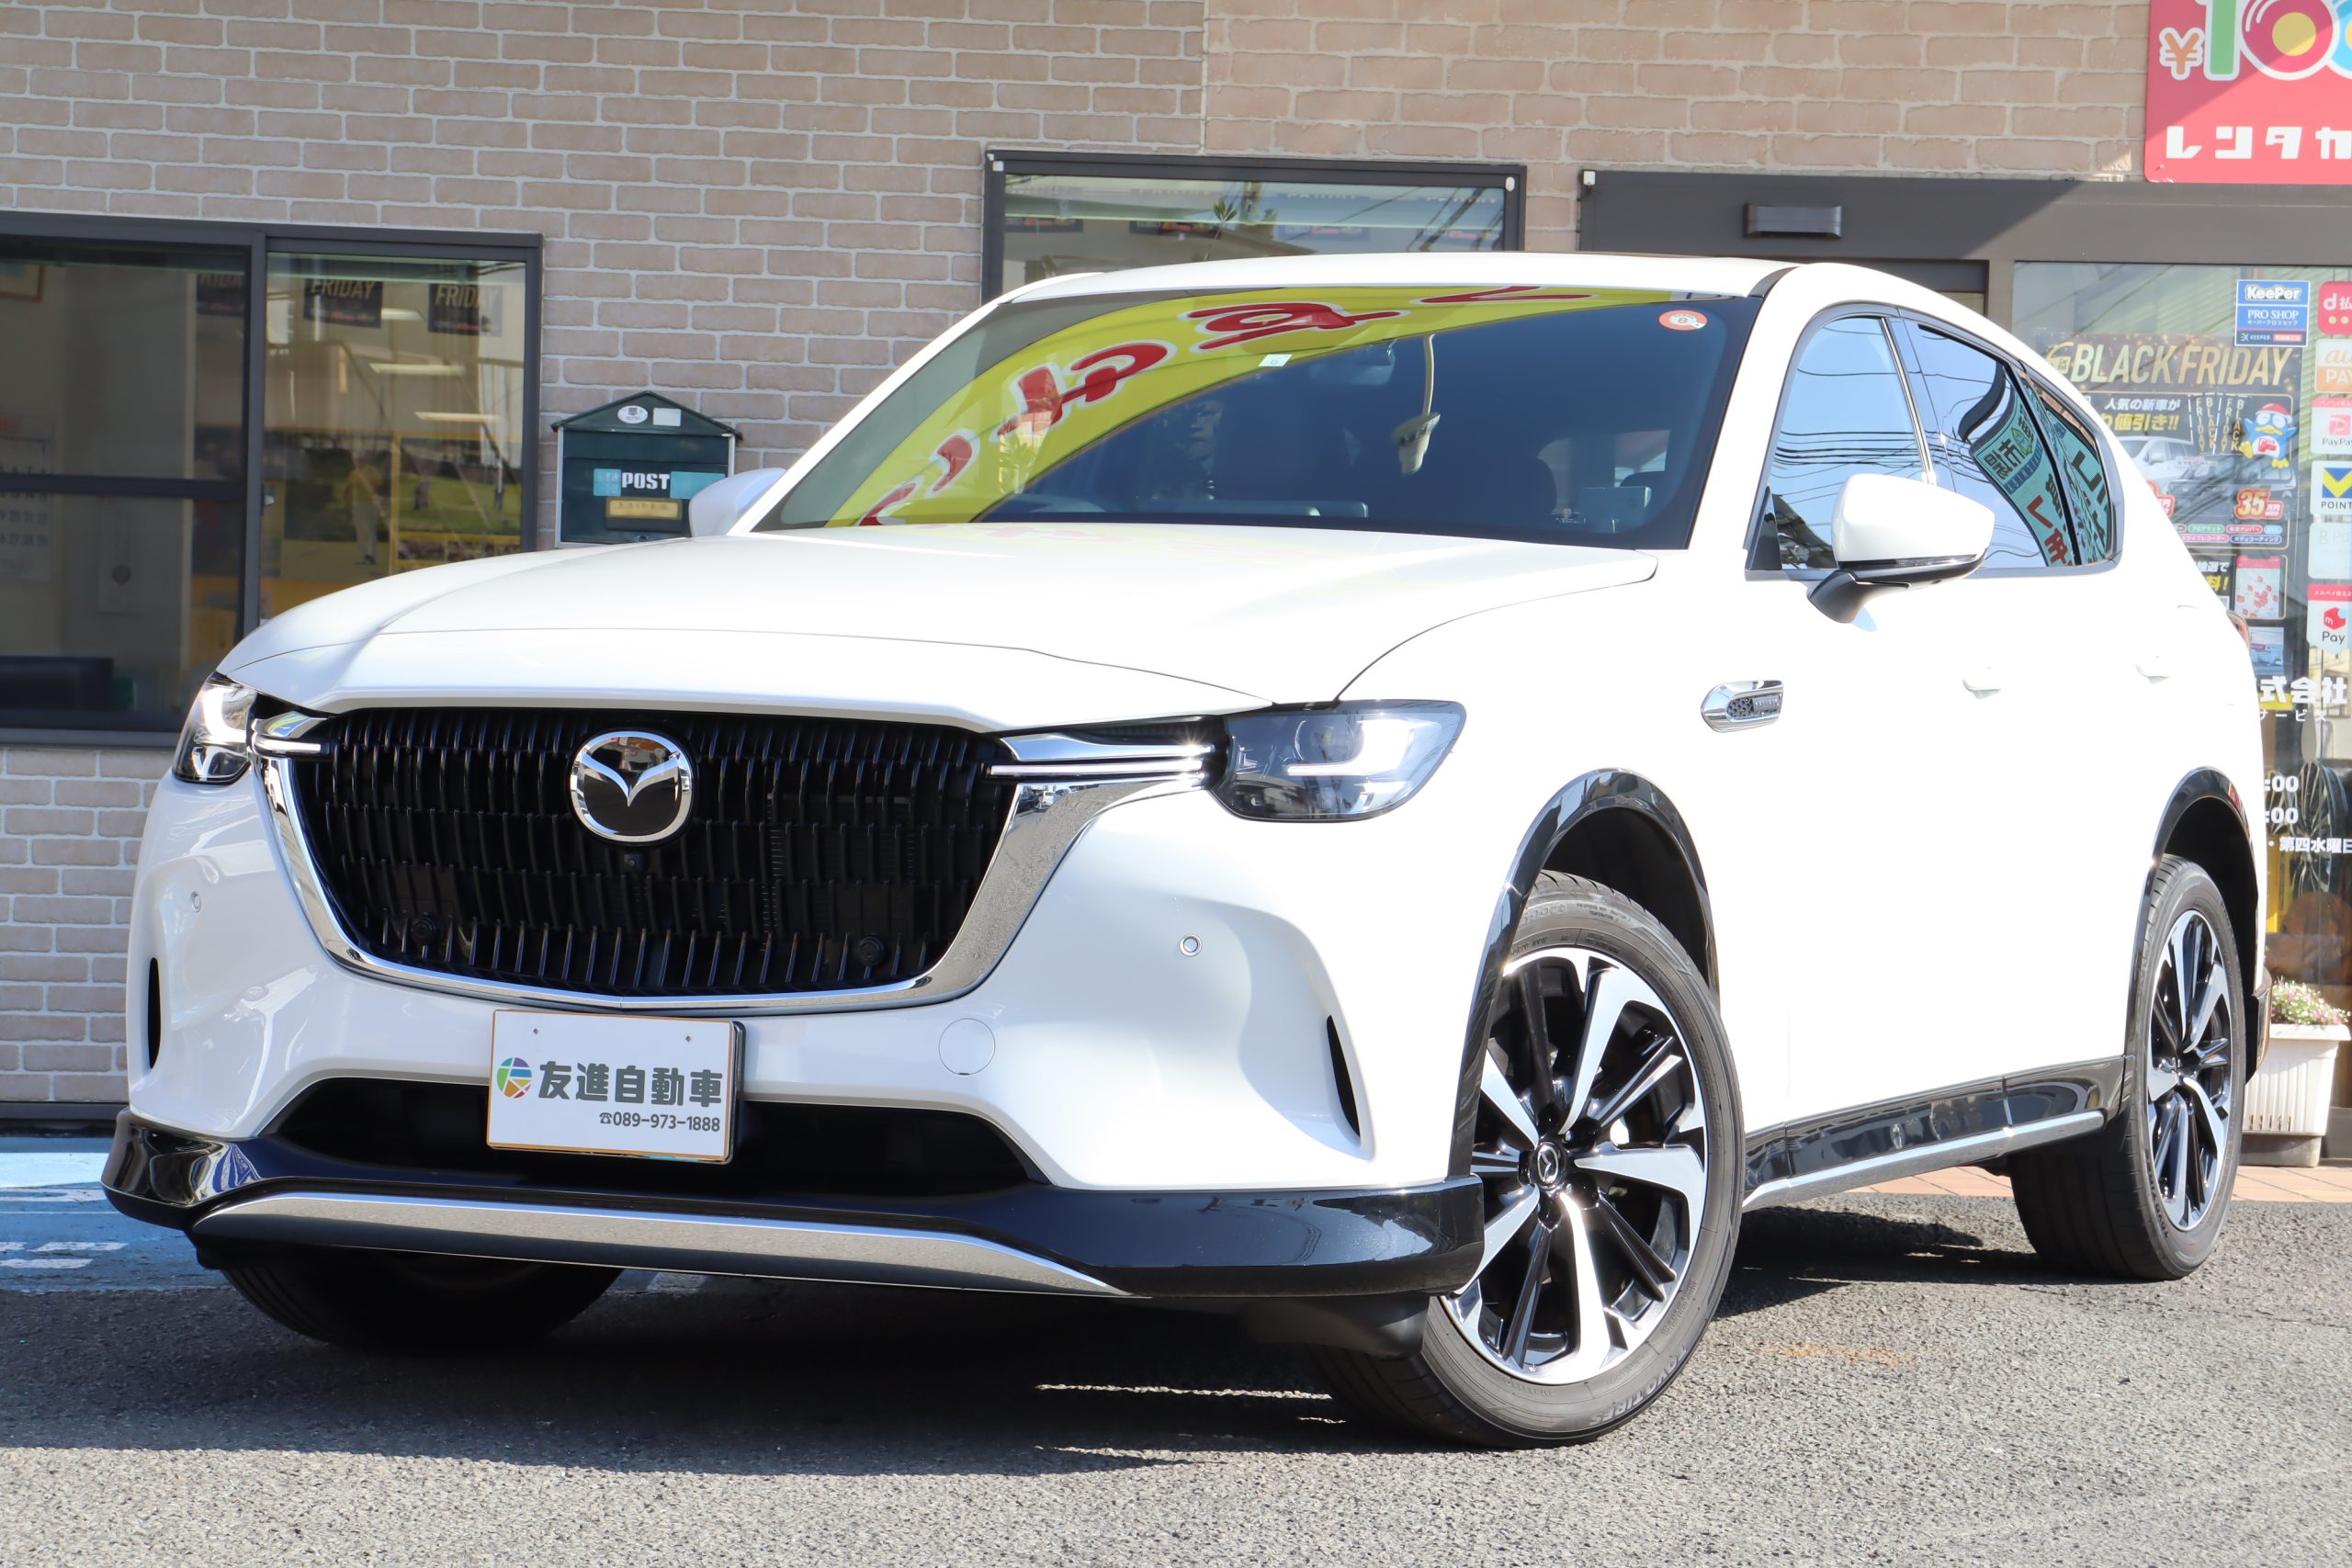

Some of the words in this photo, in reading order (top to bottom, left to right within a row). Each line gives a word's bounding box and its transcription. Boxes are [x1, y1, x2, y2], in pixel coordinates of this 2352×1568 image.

[2165, 125, 2352, 160] レンタカ
[311, 278, 374, 300] FRIDAY
[435, 284, 498, 309] FRIDAY
[2245, 285, 2301, 301] KeePer
[2247, 309, 2268, 320] PRO
[2270, 310, 2299, 320] SHOP
[2070, 343, 2177, 384] BLACK
[2177, 345, 2295, 387] FRIDAY
[2104, 397, 2180, 411] 人気の新車が
[2196, 397, 2205, 452] FRIDAY
[2205, 397, 2216, 449] BLACK
[2221, 397, 2233, 452] FRIDAY
[2231, 399, 2245, 451] BLACK
[622, 472, 670, 490] POST
[2238, 491, 2266, 516] 35
[2321, 501, 2352, 509] POINT
[2323, 631, 2346, 646] Pay
[2260, 675, 2347, 705] 式会社
[537, 1060, 723, 1108] 友進自動車
[613, 1111, 721, 1133] 089-973-1888
